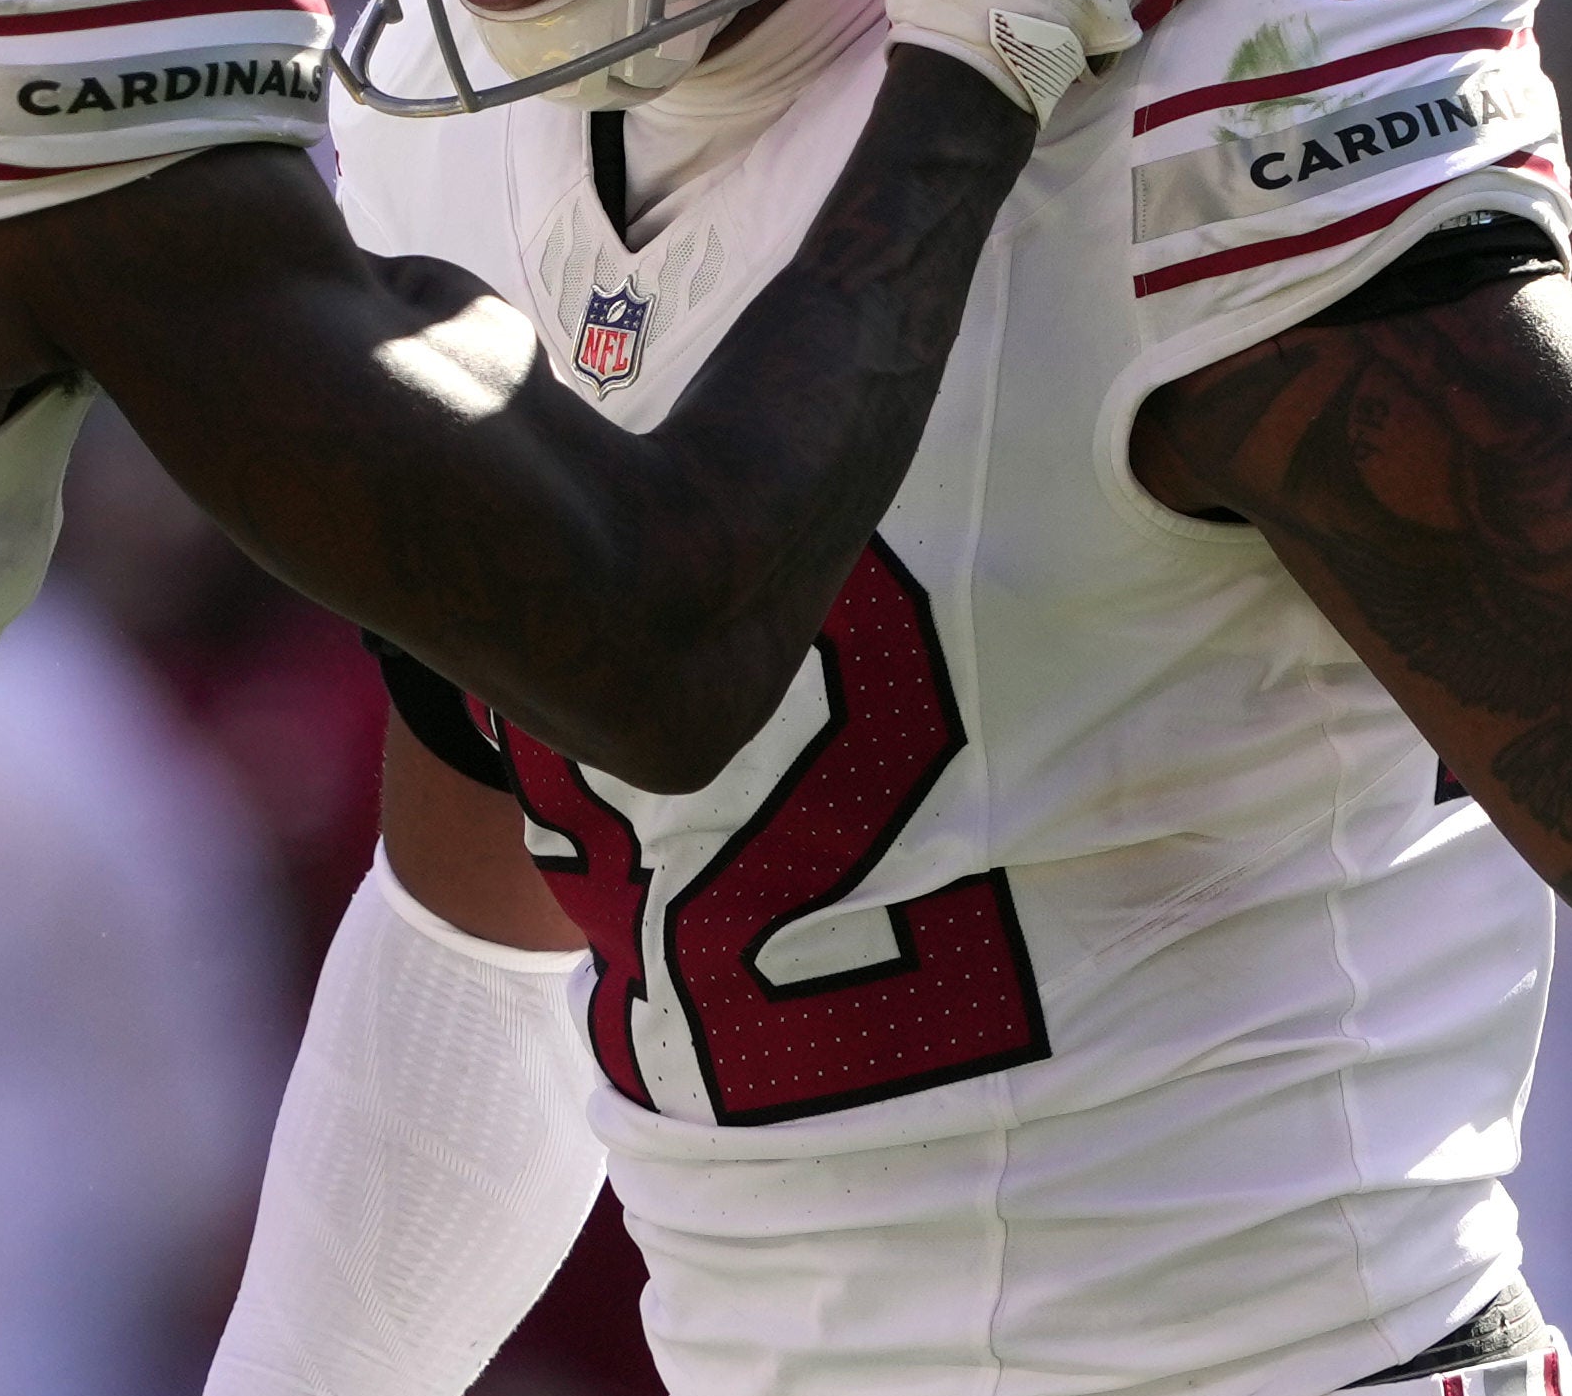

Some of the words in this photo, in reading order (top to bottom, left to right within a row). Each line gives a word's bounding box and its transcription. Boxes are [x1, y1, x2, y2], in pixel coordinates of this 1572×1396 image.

[18, 60, 322, 116] CARDINALS
[1250, 88, 1534, 190] CARDINAL
[580, 326, 629, 375] NFL
